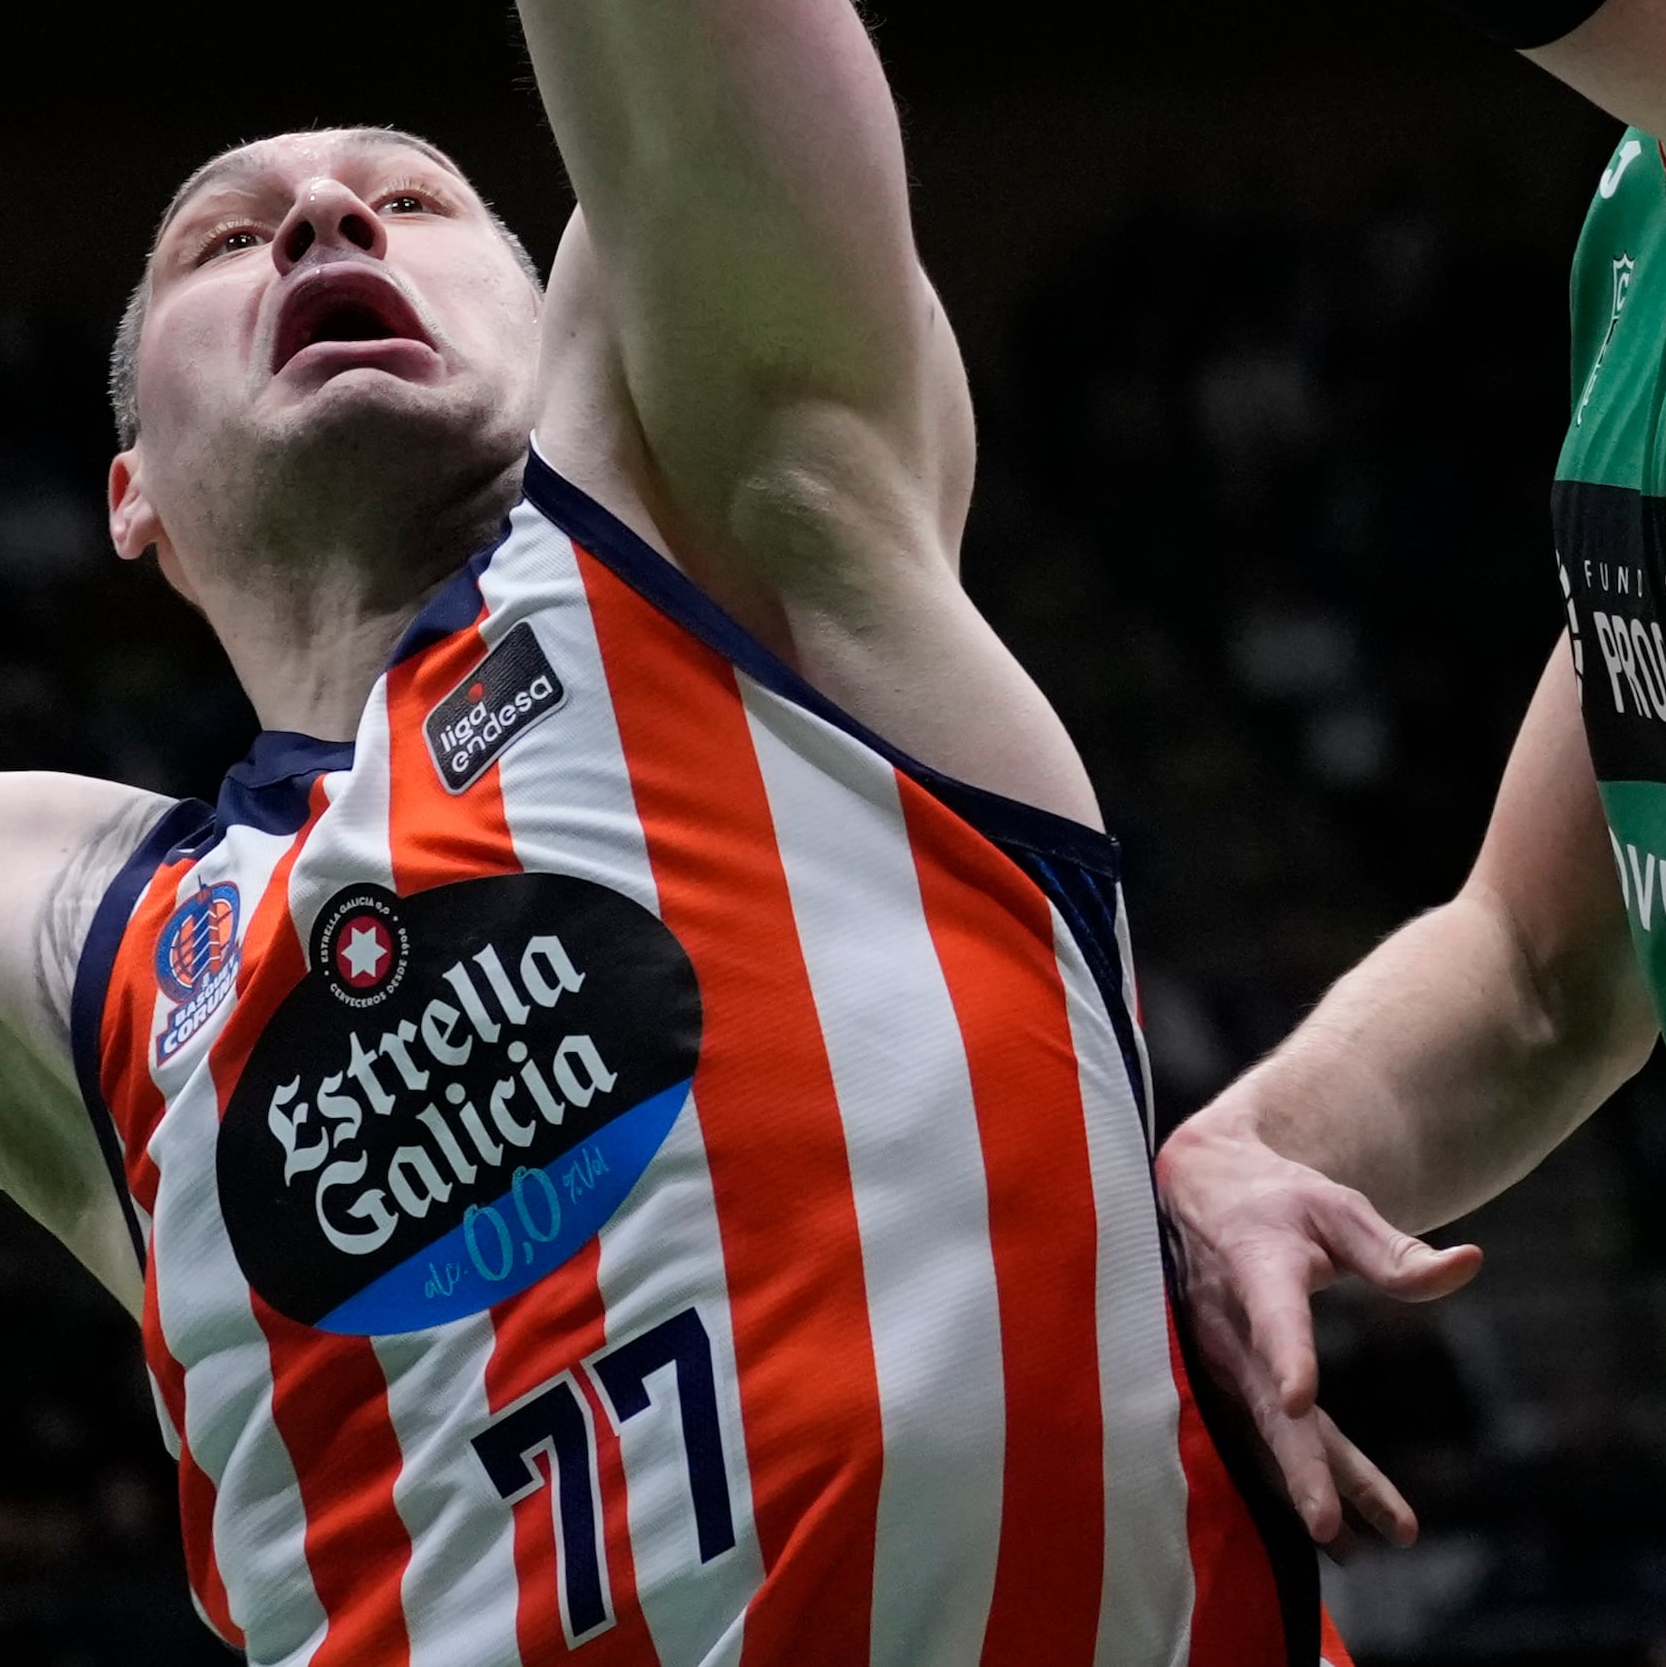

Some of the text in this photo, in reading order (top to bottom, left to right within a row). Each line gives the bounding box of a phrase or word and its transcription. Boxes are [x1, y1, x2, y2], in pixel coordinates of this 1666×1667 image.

[439, 700, 488, 753] liga
[451, 675, 554, 773] endesa
[320, 912, 342, 964] ESTRELLA
[339, 896, 374, 914] GALICIA
[329, 927, 411, 1009] CERVECEROS DESDE 1906
[266, 934, 586, 1188] Estrella
[315, 1034, 619, 1255] Galicia
[462, 1165, 562, 1282] 0,0
[469, 1305, 737, 1639] 77
